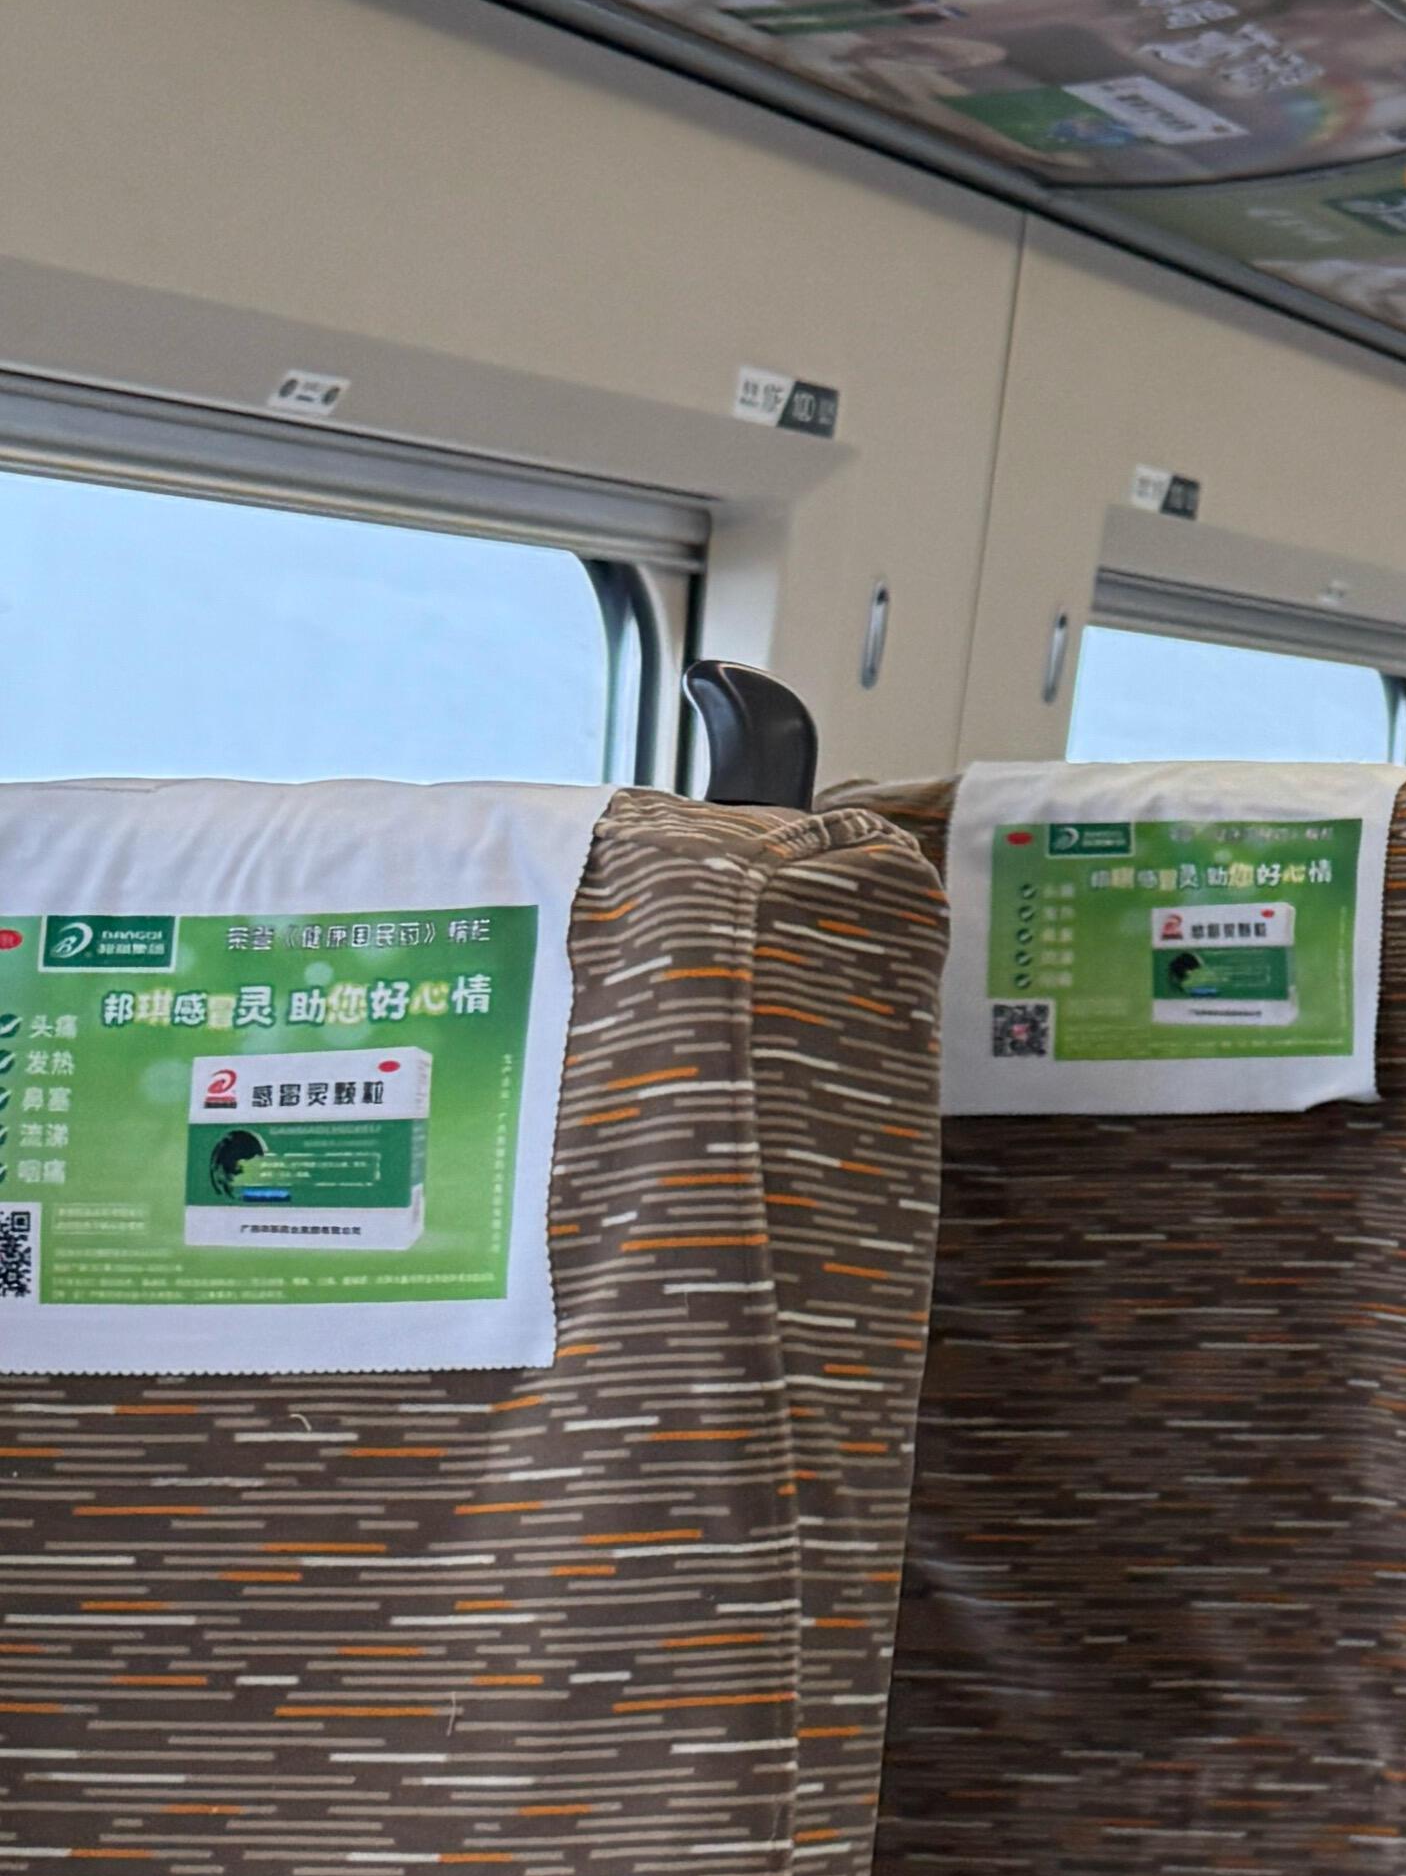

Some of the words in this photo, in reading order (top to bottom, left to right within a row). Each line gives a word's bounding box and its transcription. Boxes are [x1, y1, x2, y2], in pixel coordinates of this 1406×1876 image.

[289, 975, 492, 1024] 助您好心情
